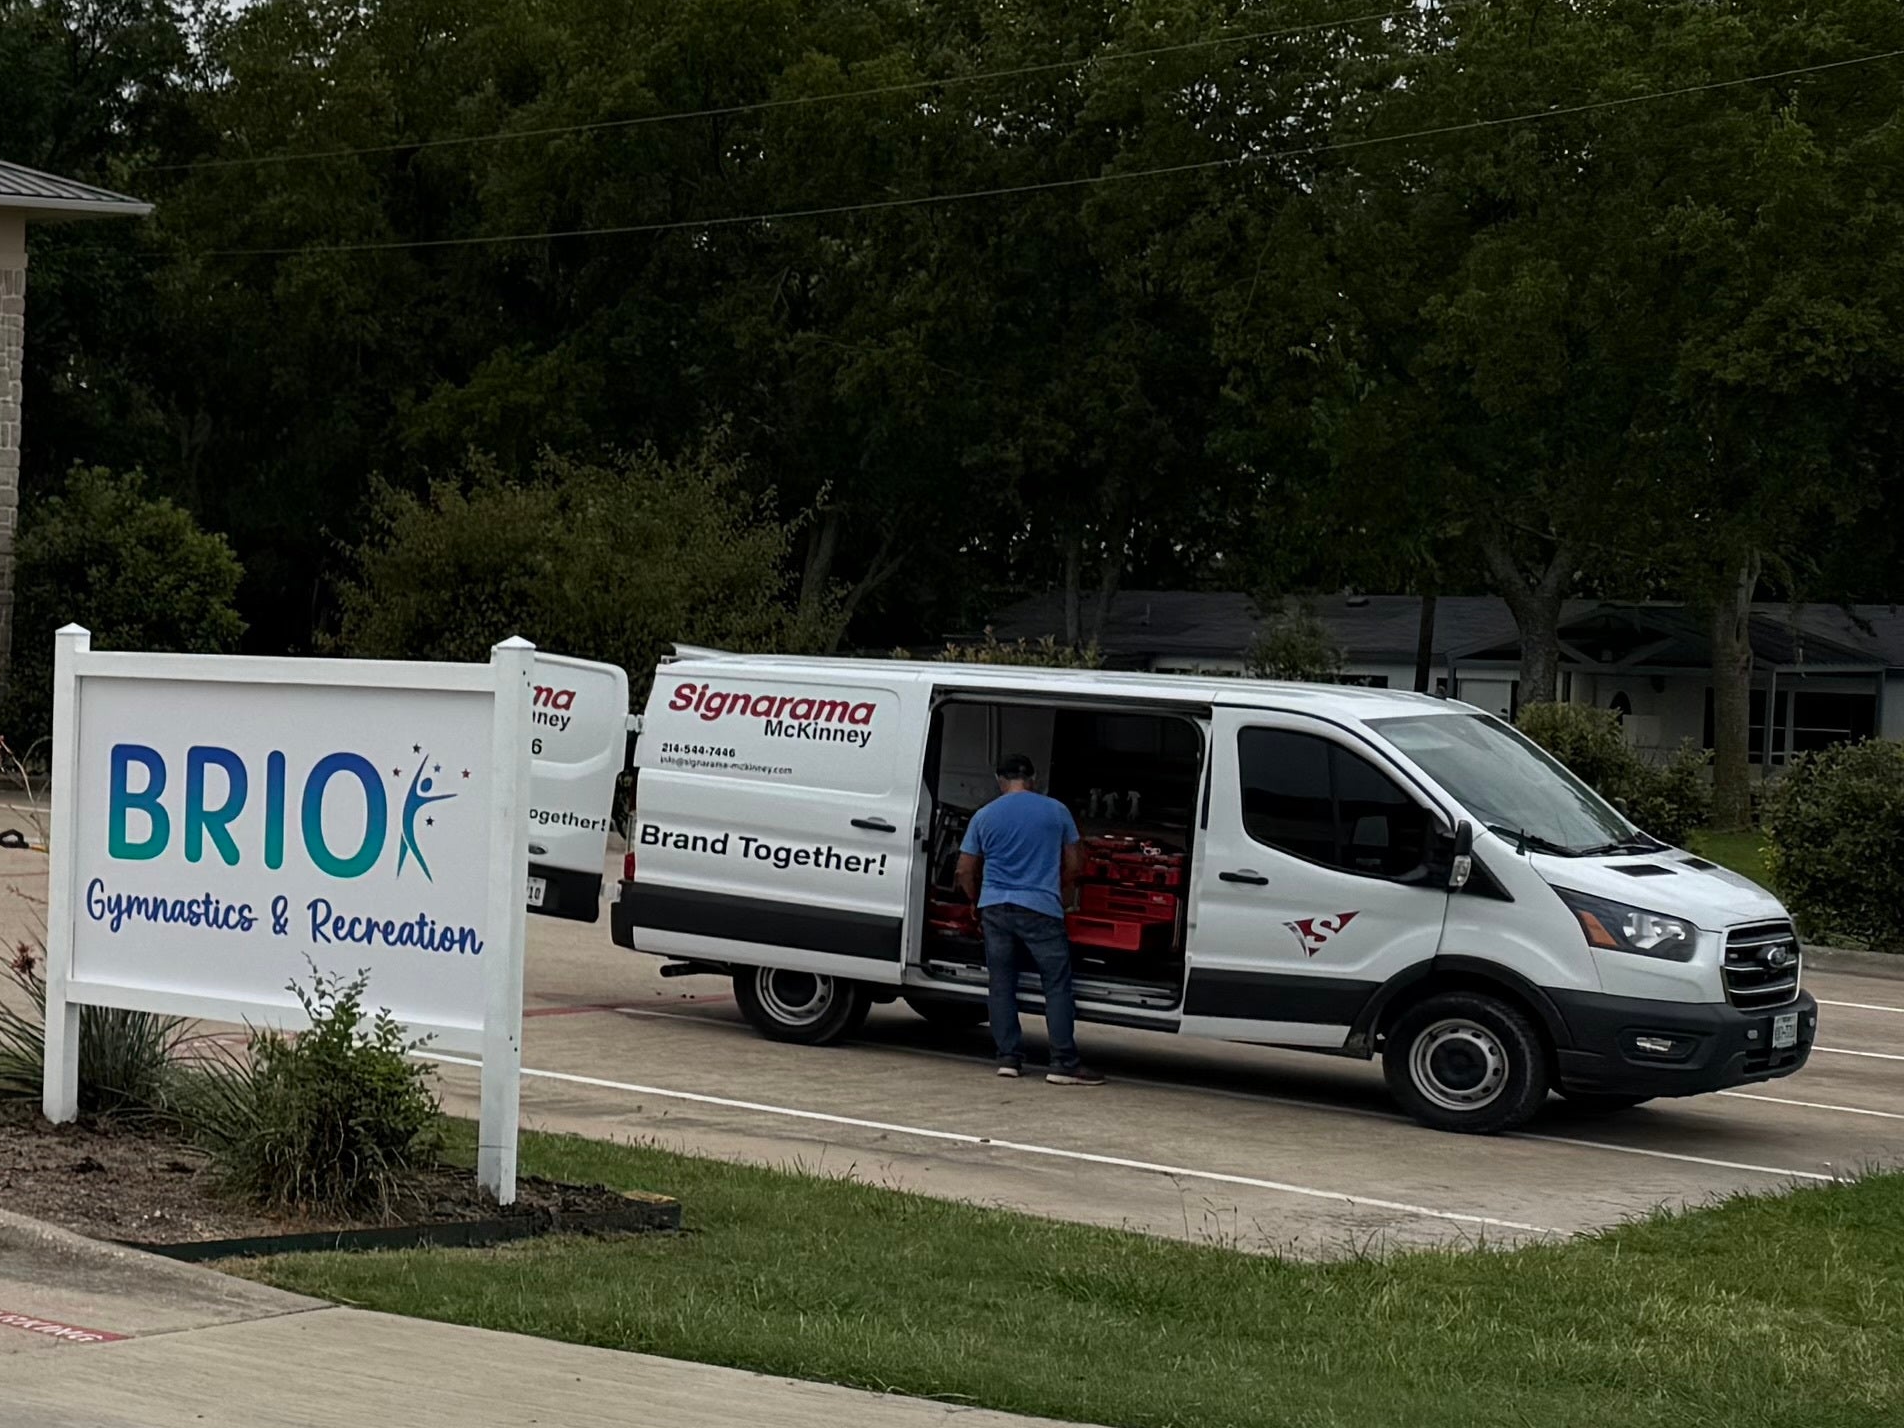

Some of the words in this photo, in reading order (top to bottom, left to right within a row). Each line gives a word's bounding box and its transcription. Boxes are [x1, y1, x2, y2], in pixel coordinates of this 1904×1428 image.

[668, 683, 877, 725] Signarama
[764, 719, 872, 748] McKinney
[108, 743, 388, 879] BRIO
[529, 809, 607, 832] ogether!
[640, 824, 730, 855] Brand
[739, 836, 888, 876] Together!
[86, 878, 258, 933] Gymnastics
[271, 895, 288, 935] &
[306, 898, 484, 955] Recreation
